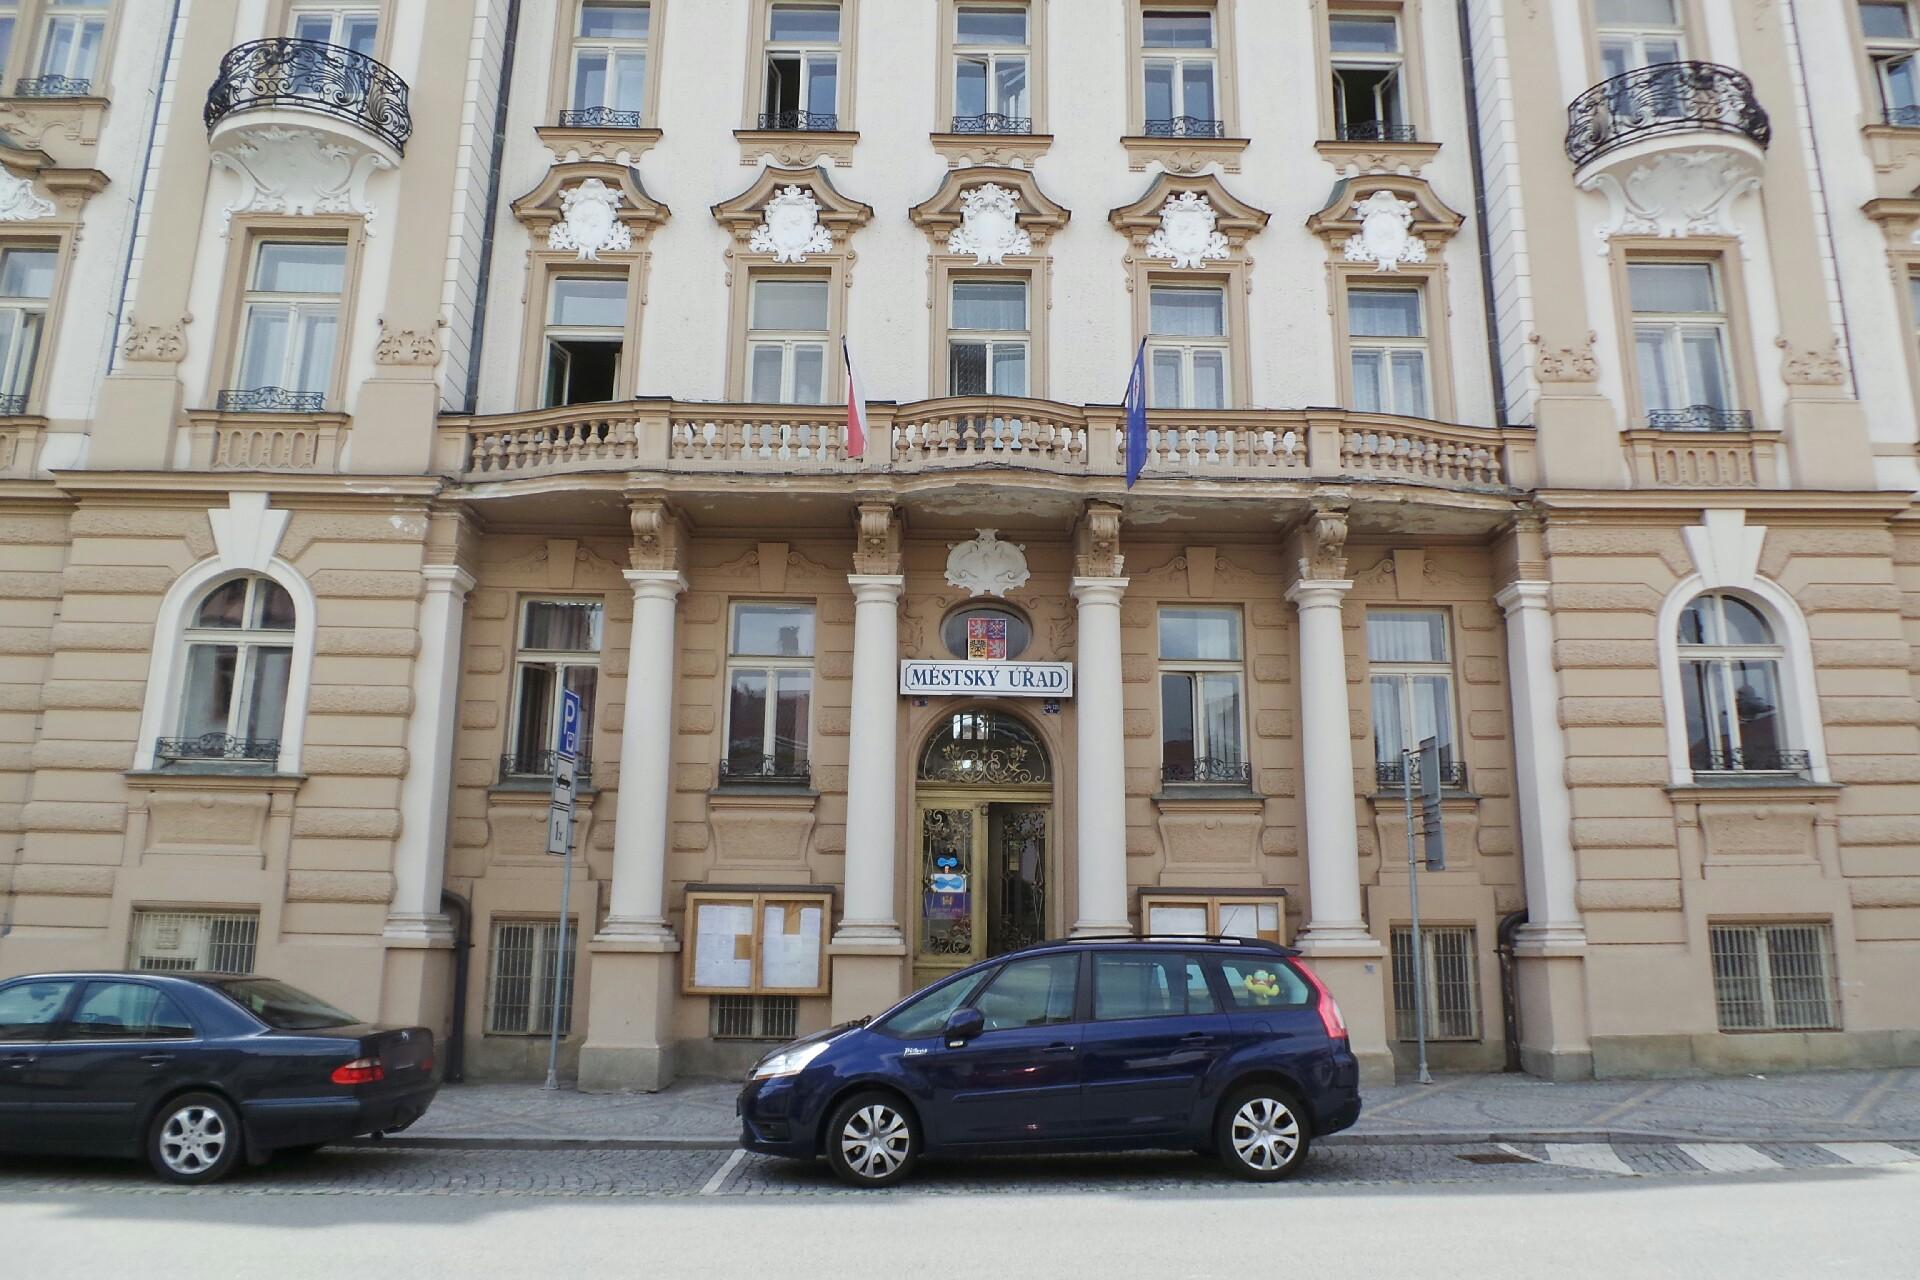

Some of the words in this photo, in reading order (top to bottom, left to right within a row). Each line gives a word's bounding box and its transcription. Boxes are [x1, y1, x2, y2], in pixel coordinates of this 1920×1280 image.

[911, 665, 999, 686] MĚSTSKÝ
[1009, 666, 1063, 688] ÚŘAD
[564, 698, 576, 735] P
